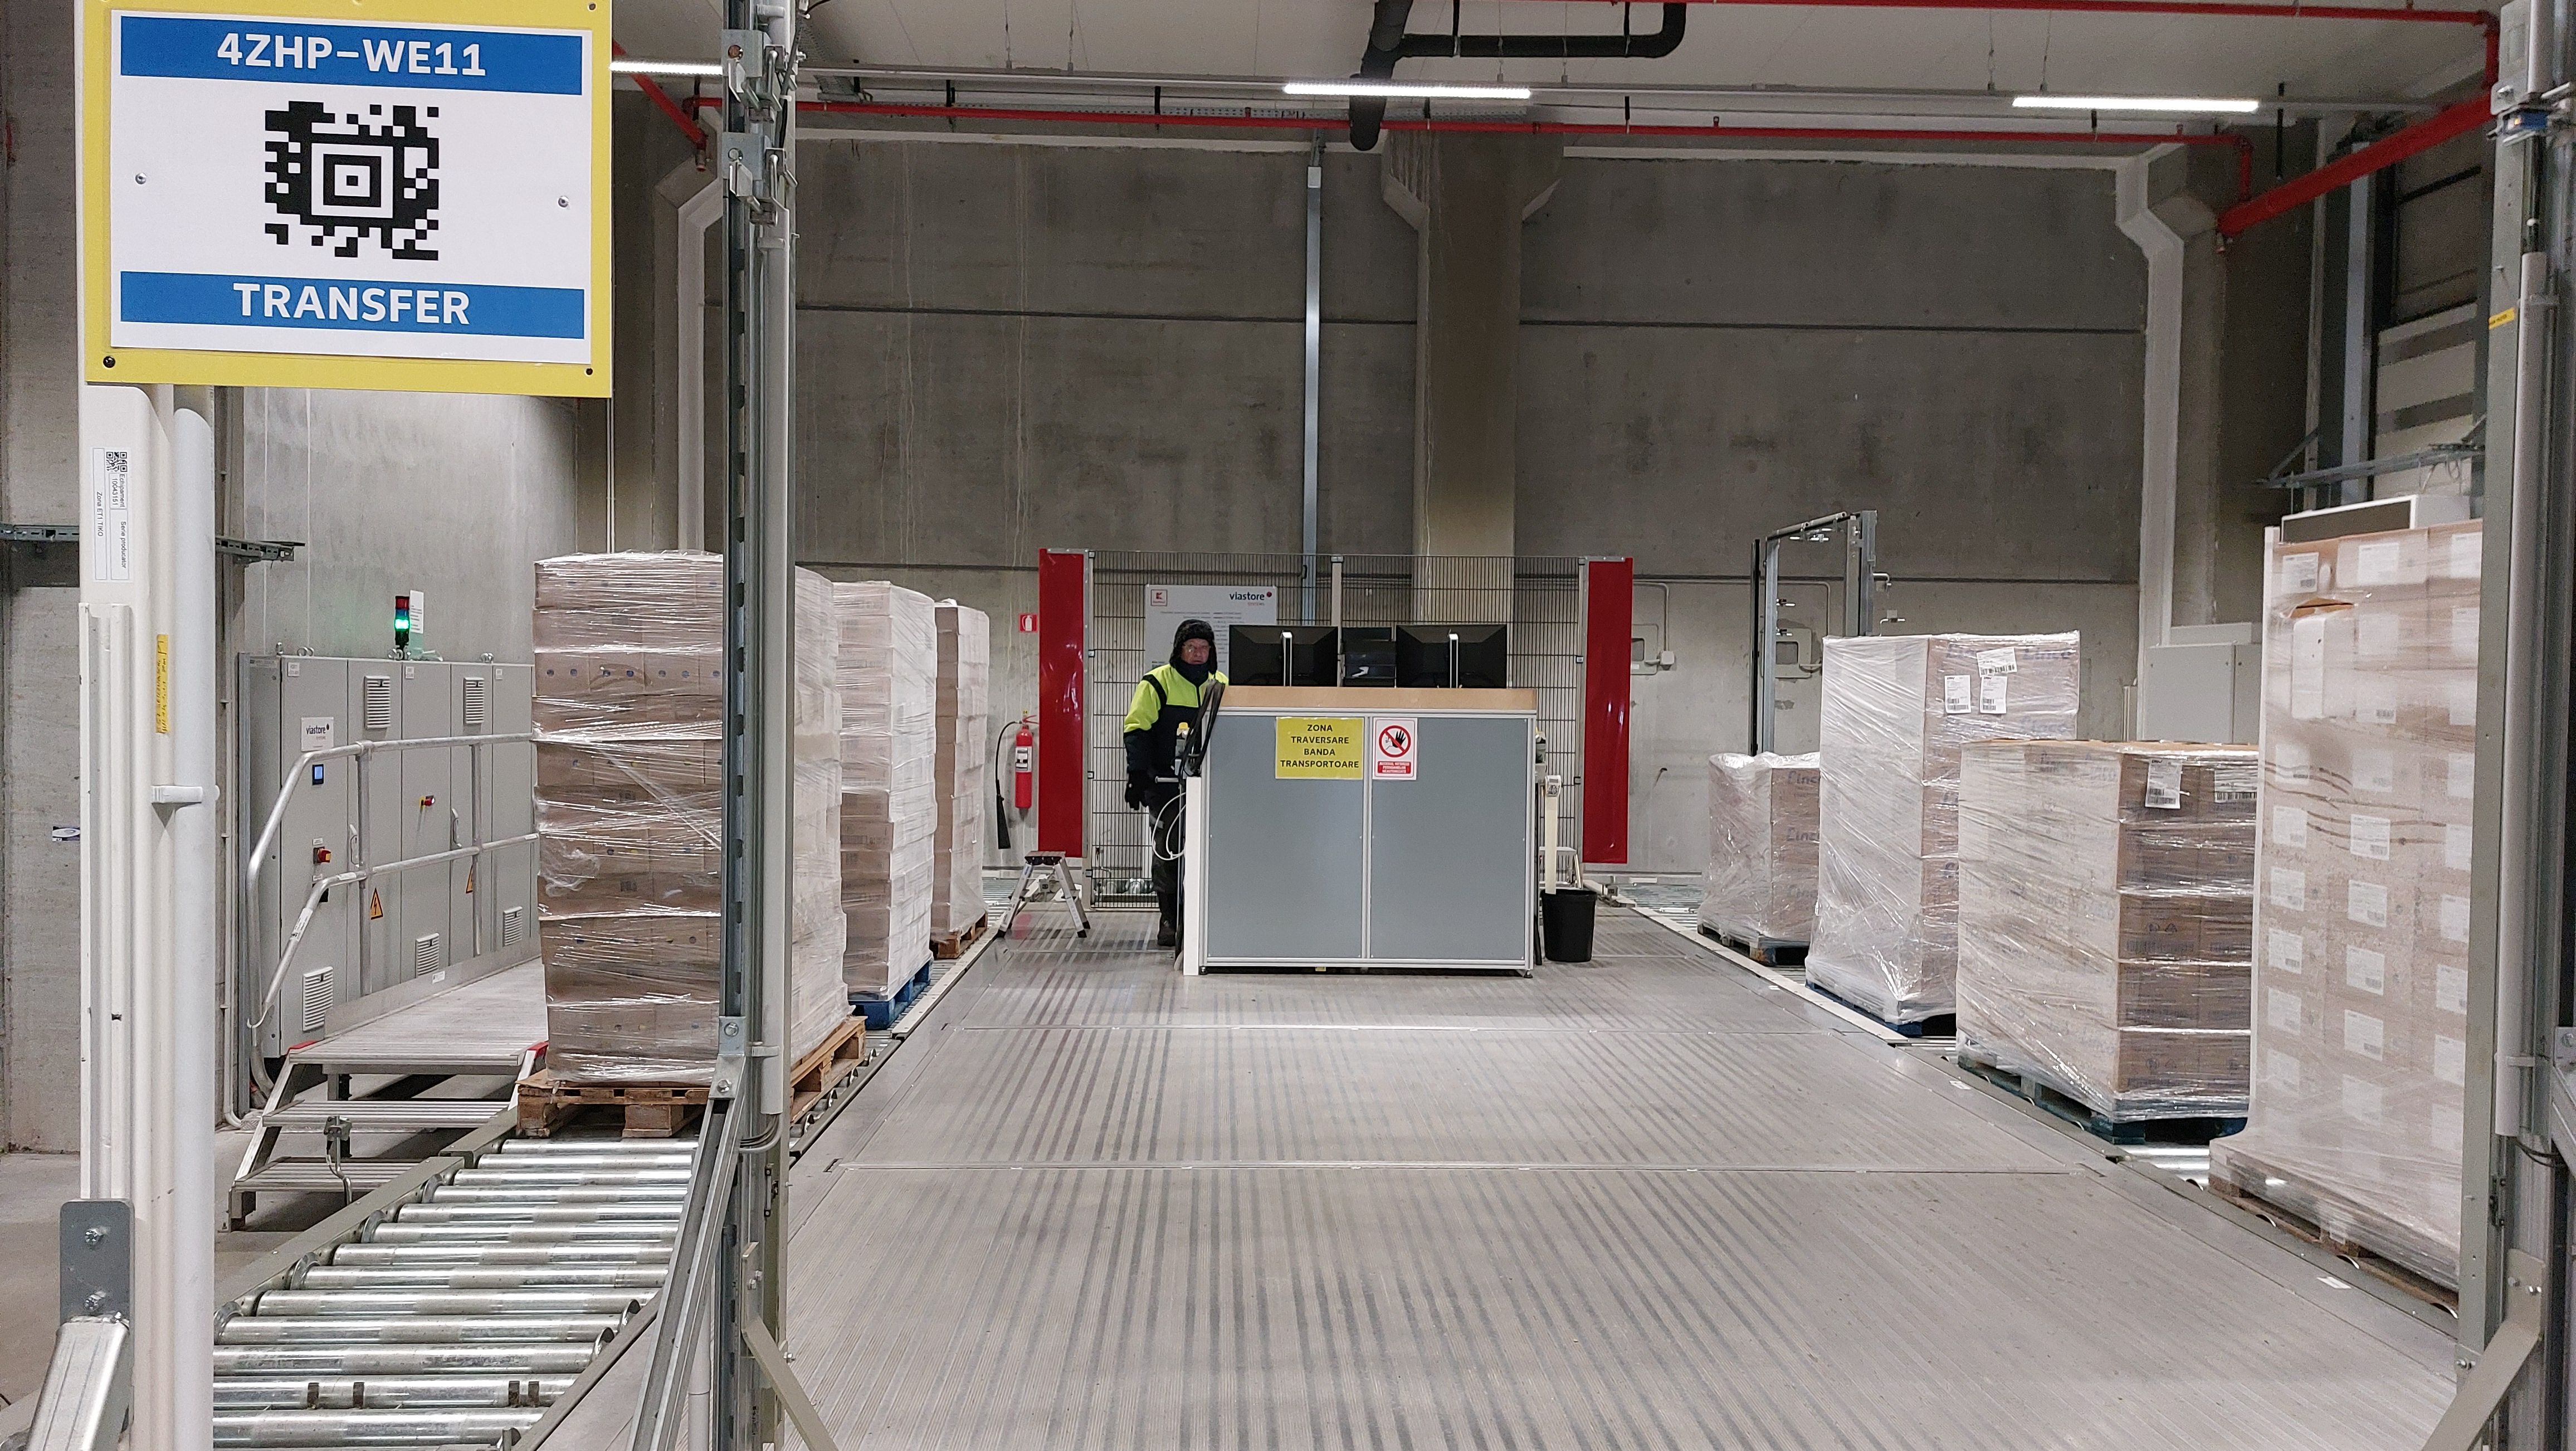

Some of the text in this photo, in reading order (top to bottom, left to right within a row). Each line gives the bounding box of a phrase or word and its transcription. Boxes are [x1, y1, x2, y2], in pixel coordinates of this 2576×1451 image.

[217, 33, 486, 76] 4ZHP-WE11
[233, 283, 470, 324] TRANSFER
[1230, 591, 1265, 601] viastore
[306, 725, 326, 734] viastore
